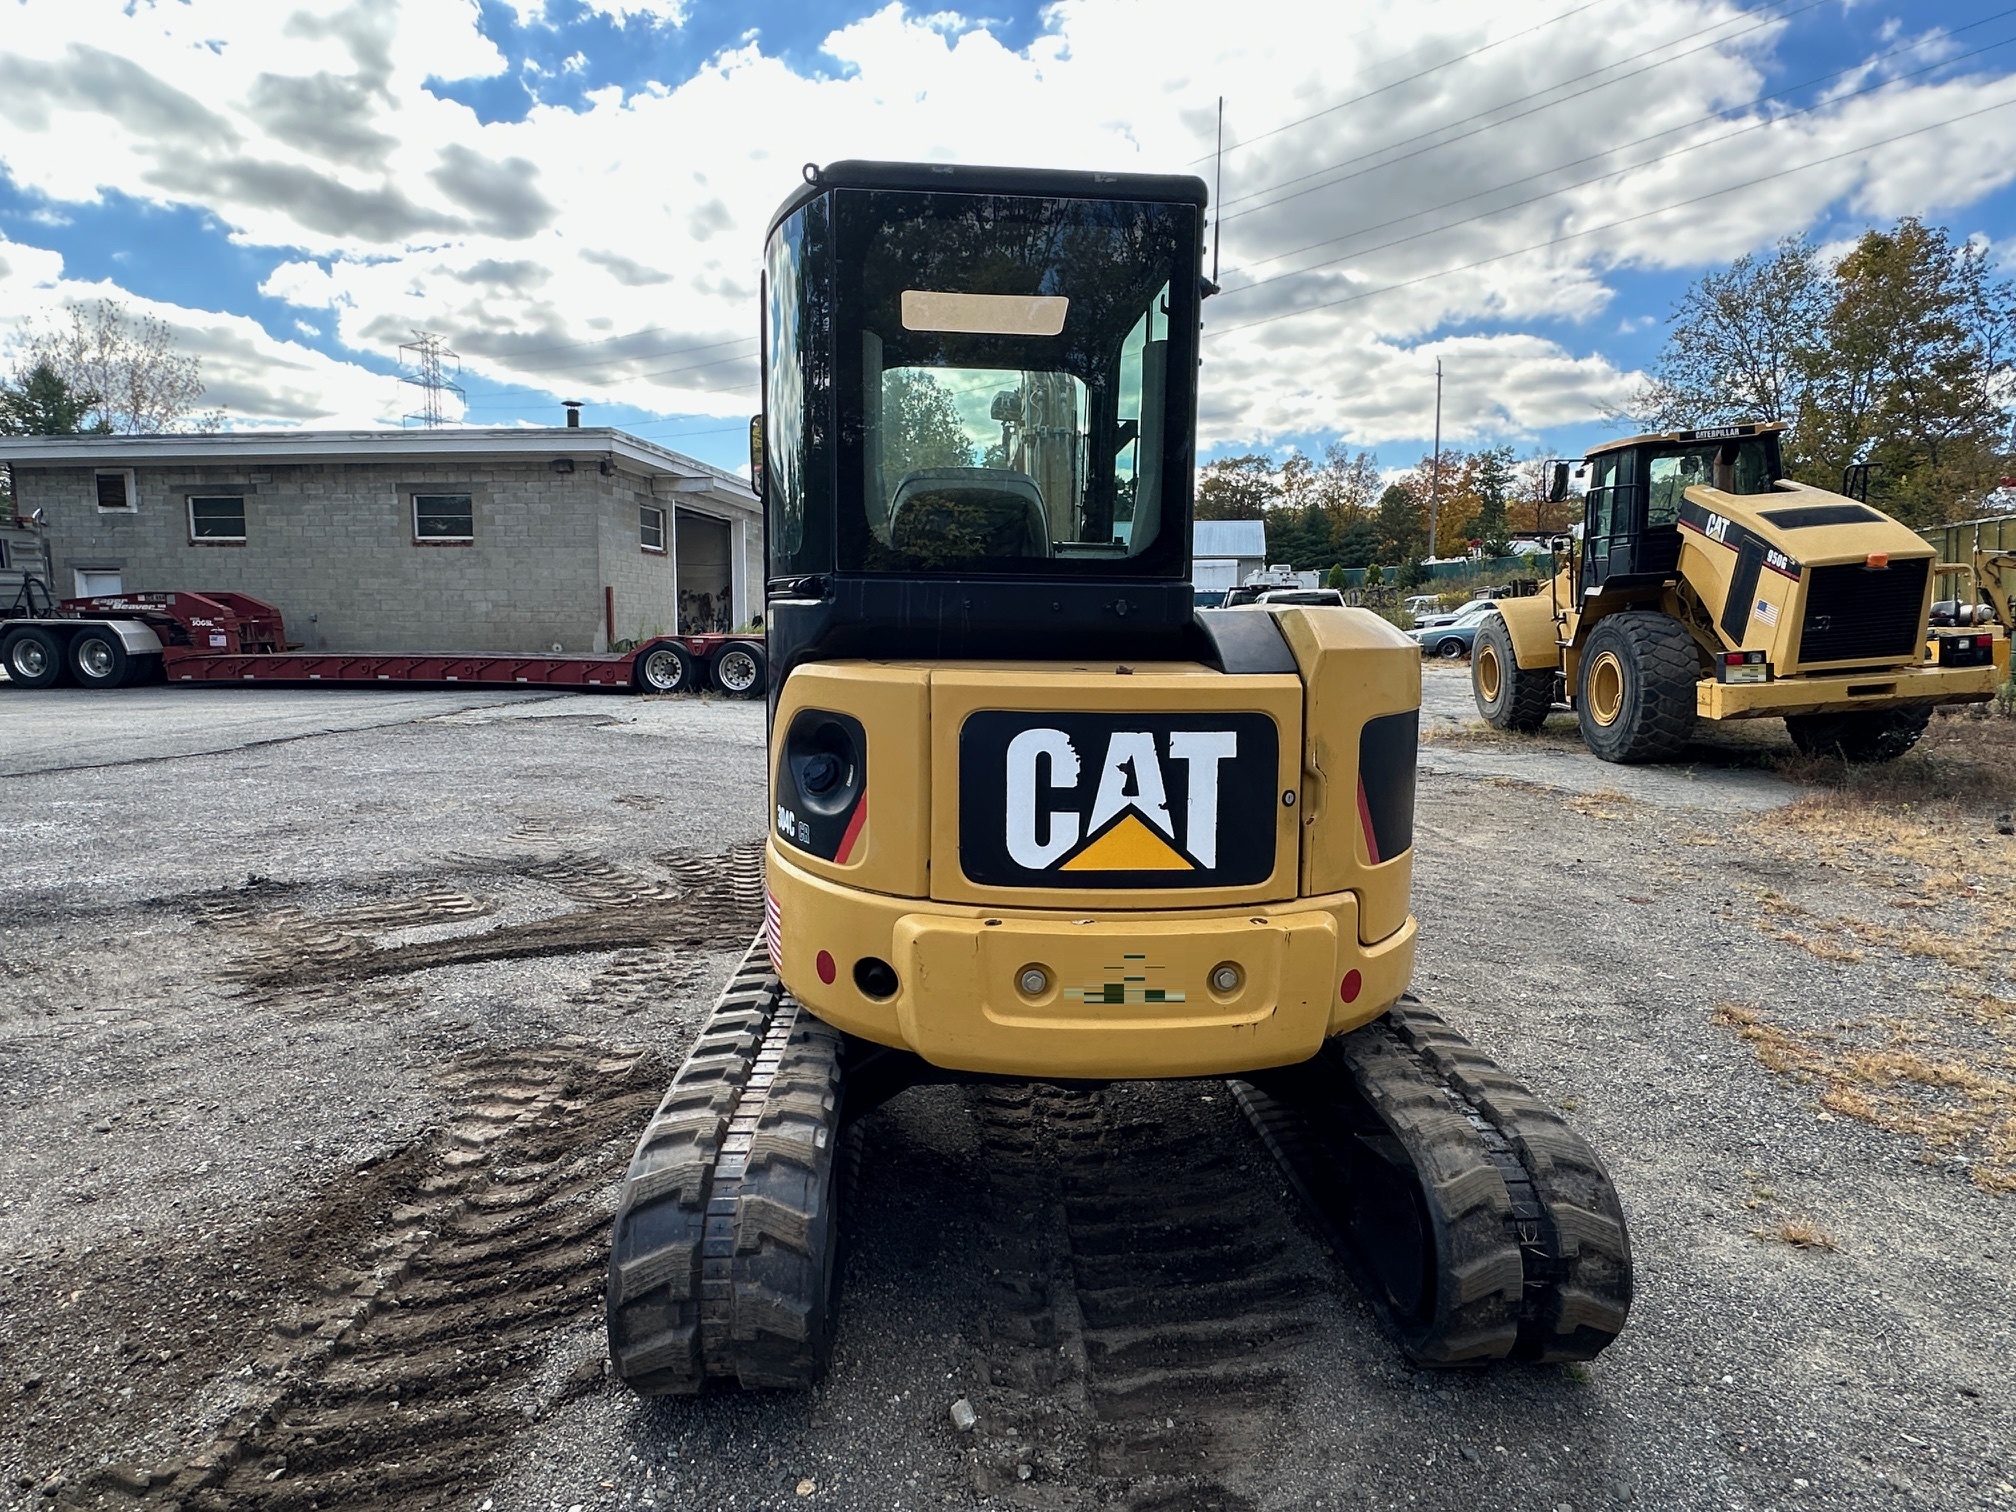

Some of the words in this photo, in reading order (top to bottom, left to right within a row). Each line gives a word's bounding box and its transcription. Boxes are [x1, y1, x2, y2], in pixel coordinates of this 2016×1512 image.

[1695, 427, 1740, 439] CATERPILLAR
[1705, 513, 1731, 544] CAT
[1766, 549, 1788, 570] 950G
[91, 598, 128, 606] Eager
[112, 603, 155, 611] Beaver
[1006, 727, 1238, 870] CAT
